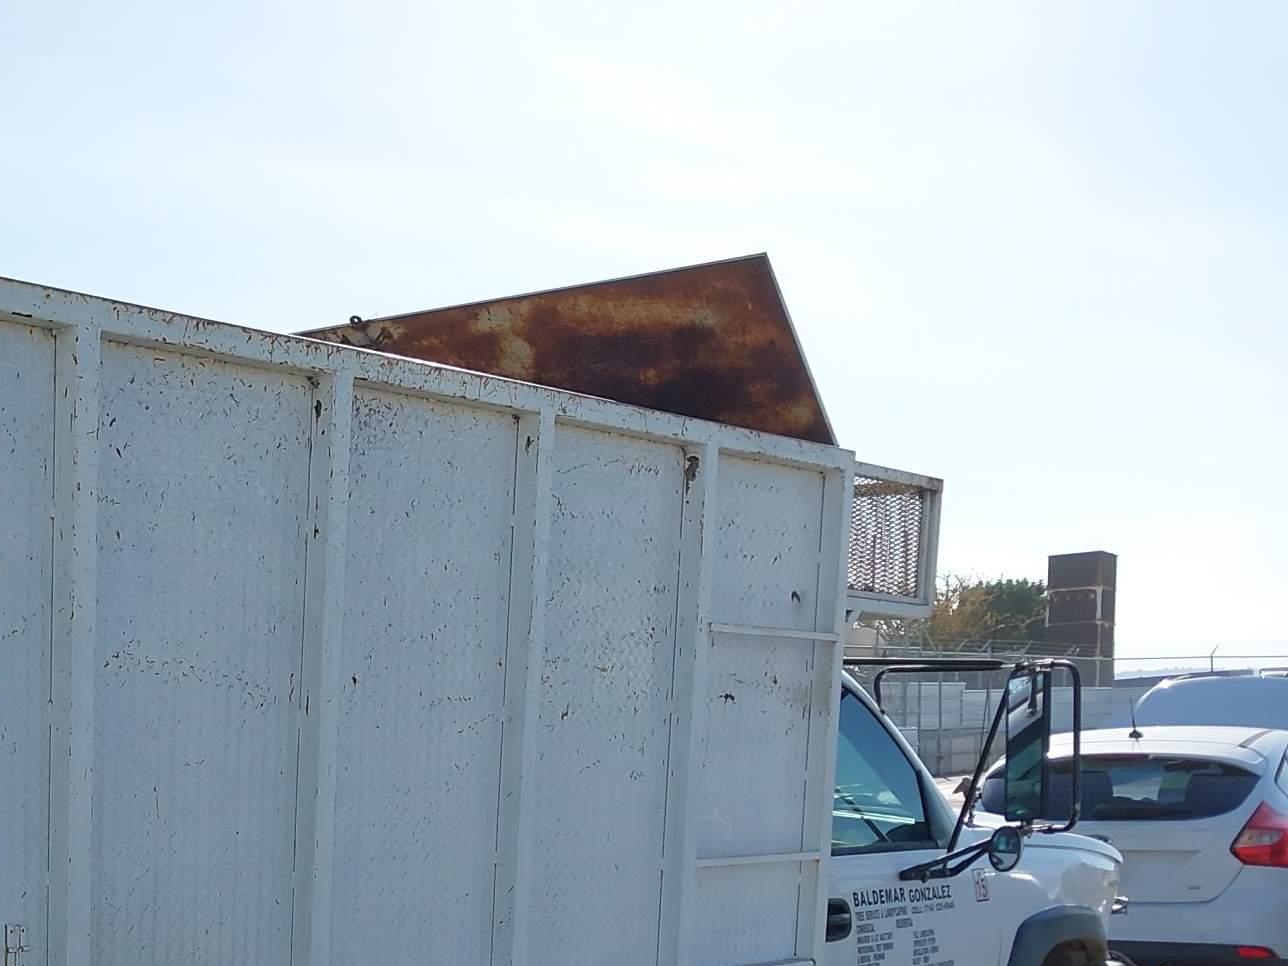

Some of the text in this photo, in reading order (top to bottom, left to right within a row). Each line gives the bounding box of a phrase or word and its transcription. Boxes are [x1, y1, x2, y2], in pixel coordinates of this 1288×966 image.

[853, 884, 952, 907] BALDEMAR GONZALEZ
[975, 878, 988, 898] 15
